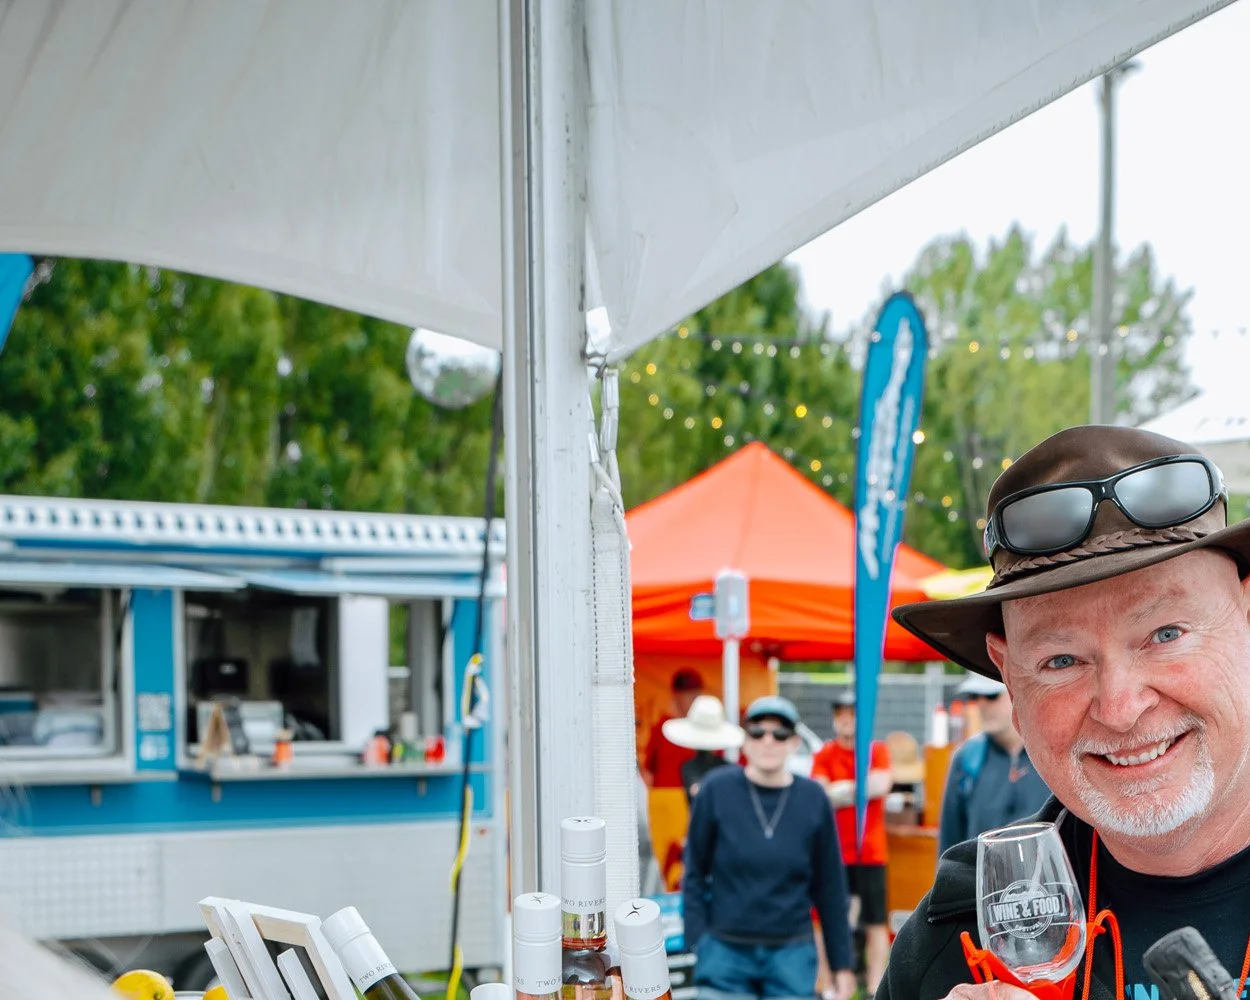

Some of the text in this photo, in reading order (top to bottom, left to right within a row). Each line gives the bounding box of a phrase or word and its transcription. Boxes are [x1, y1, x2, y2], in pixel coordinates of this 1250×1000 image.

[992, 896, 1060, 921] WINE & FOOD
[359, 970, 375, 984] TWO
[536, 978, 557, 988] TWO
[629, 983, 662, 994] RIVERS
